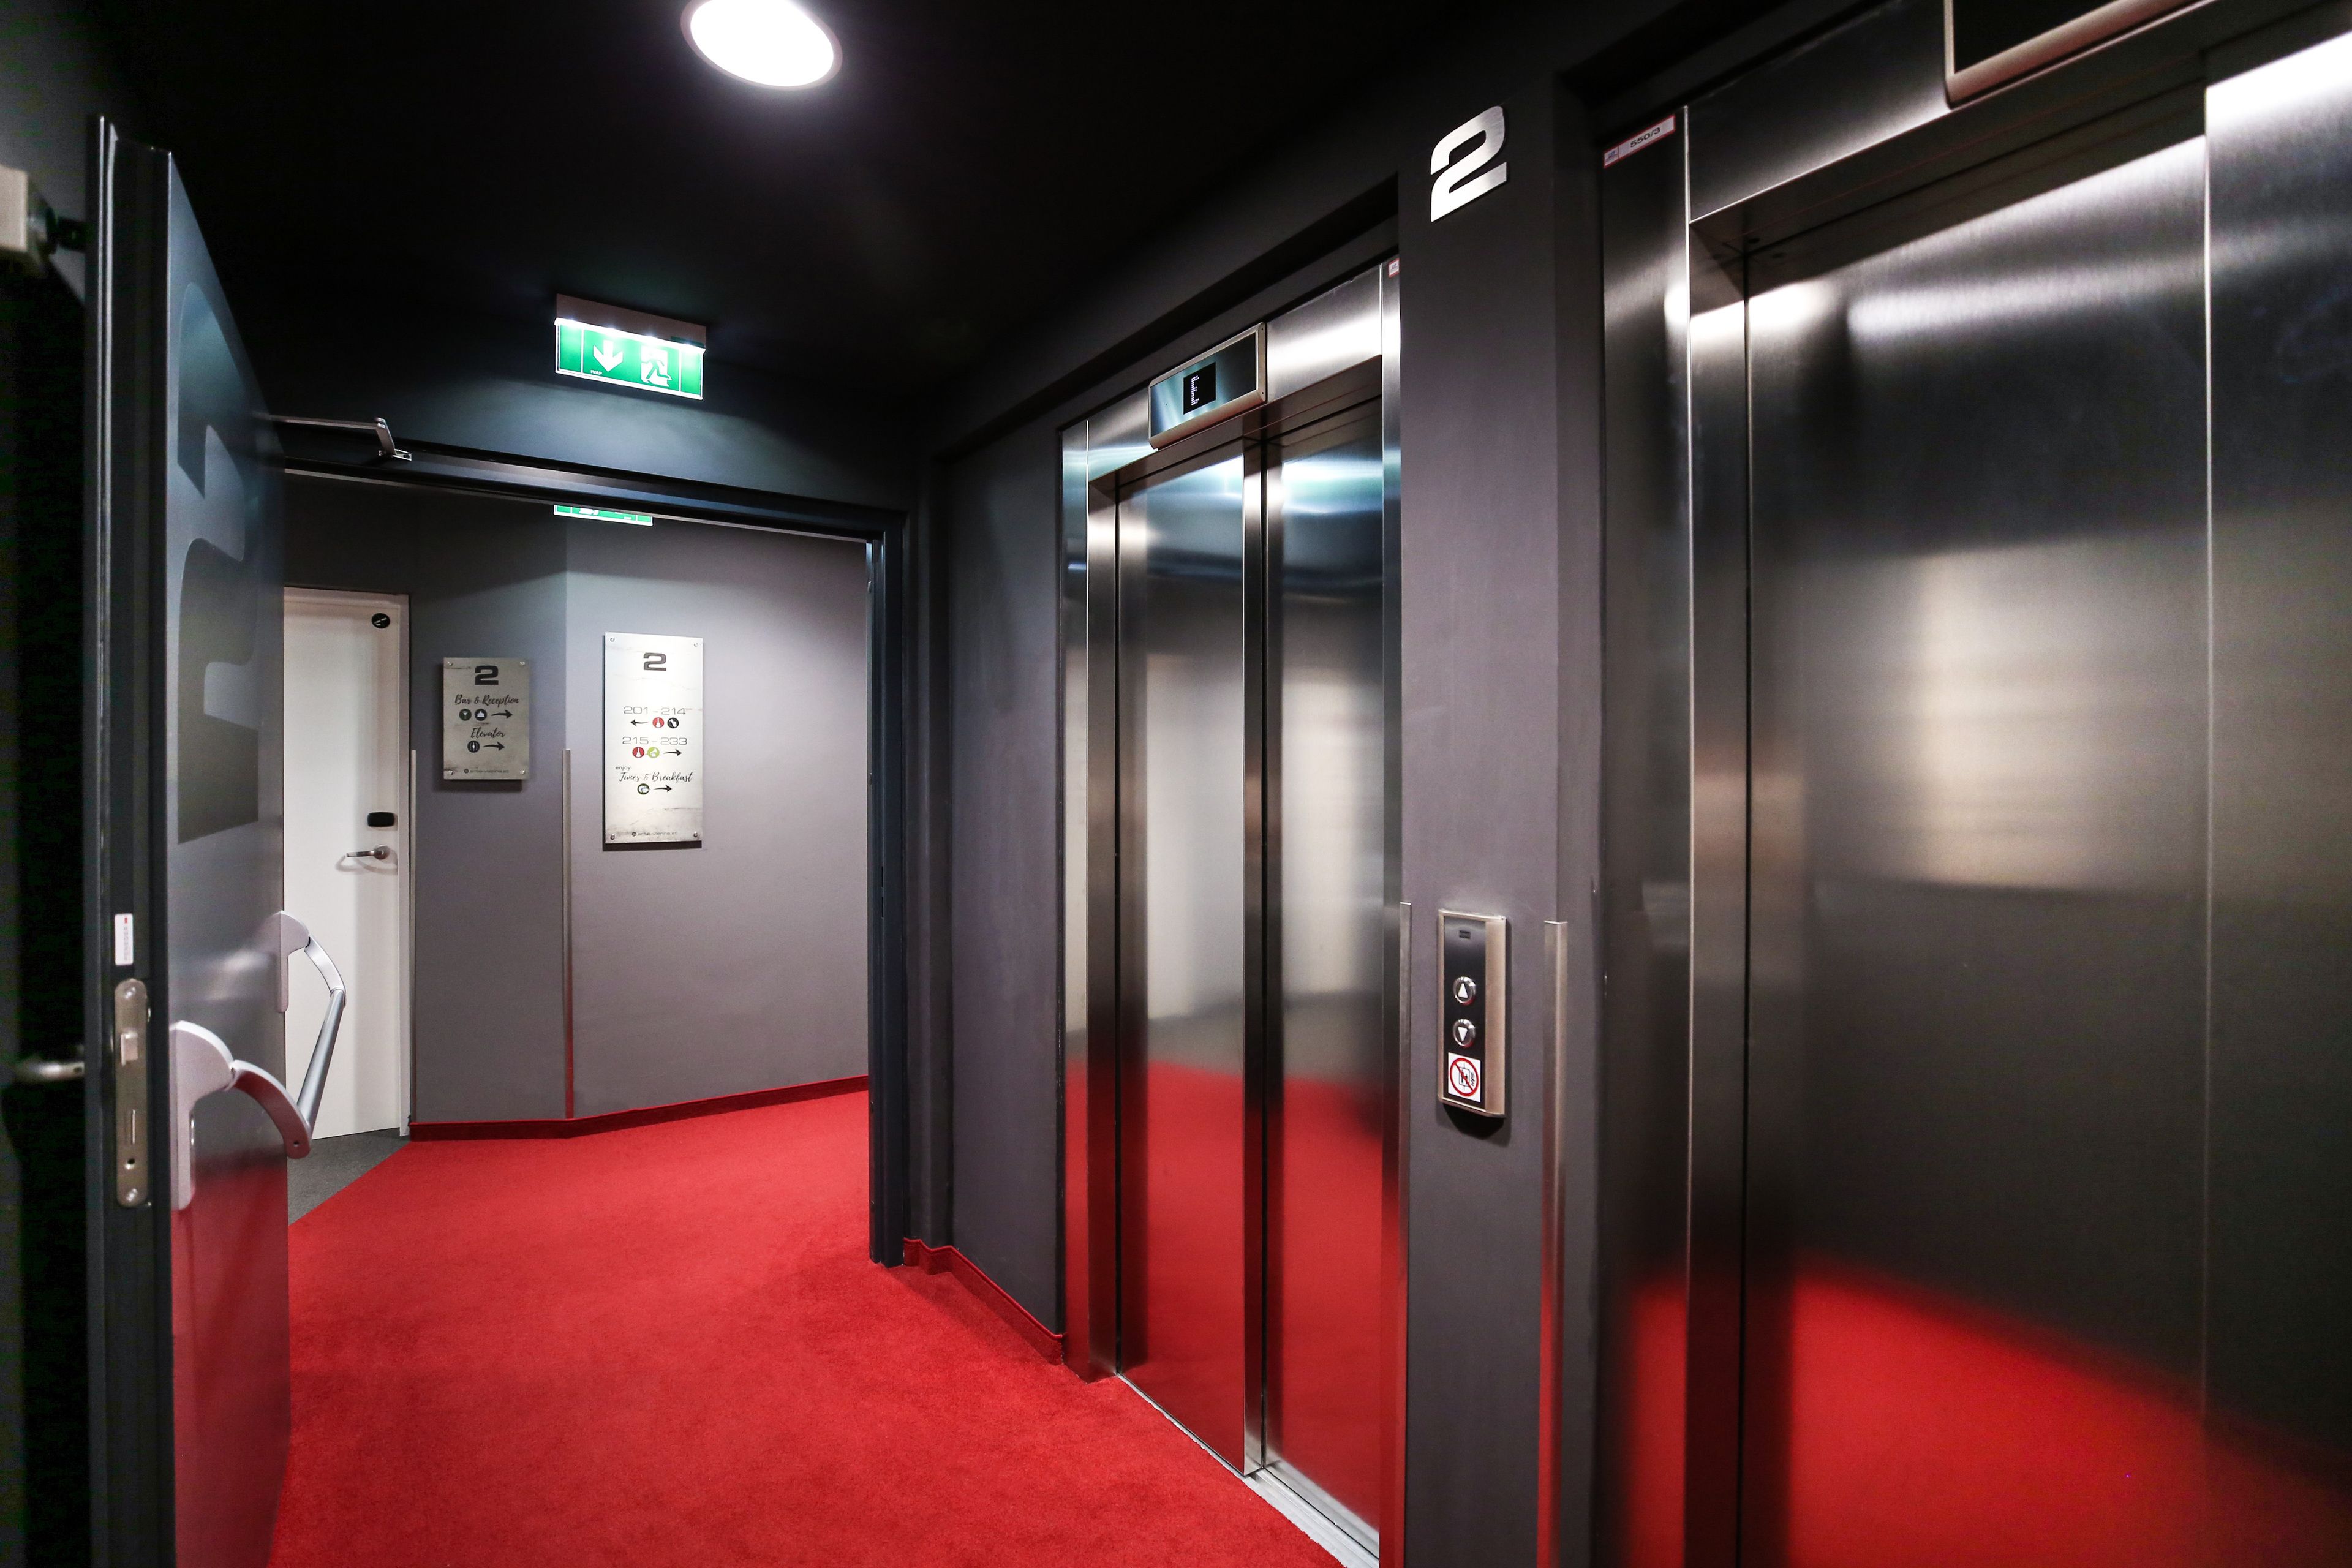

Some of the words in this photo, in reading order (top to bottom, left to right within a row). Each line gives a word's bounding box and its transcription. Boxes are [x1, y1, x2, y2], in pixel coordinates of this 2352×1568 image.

[1630, 127, 1660, 148] 550/3
[1430, 105, 1507, 222] 2
[1191, 375, 1200, 405] E
[643, 652, 667, 671] 2
[475, 665, 499, 685] 2
[455, 694, 472, 705] Bar
[482, 694, 519, 707] Reception
[624, 706, 648, 715] 201
[470, 727, 505, 739] Elevator
[622, 736, 649, 745] 215
[660, 737, 687, 745] 233
[619, 772, 639, 782] Tunes
[652, 771, 693, 783] Breakfast
